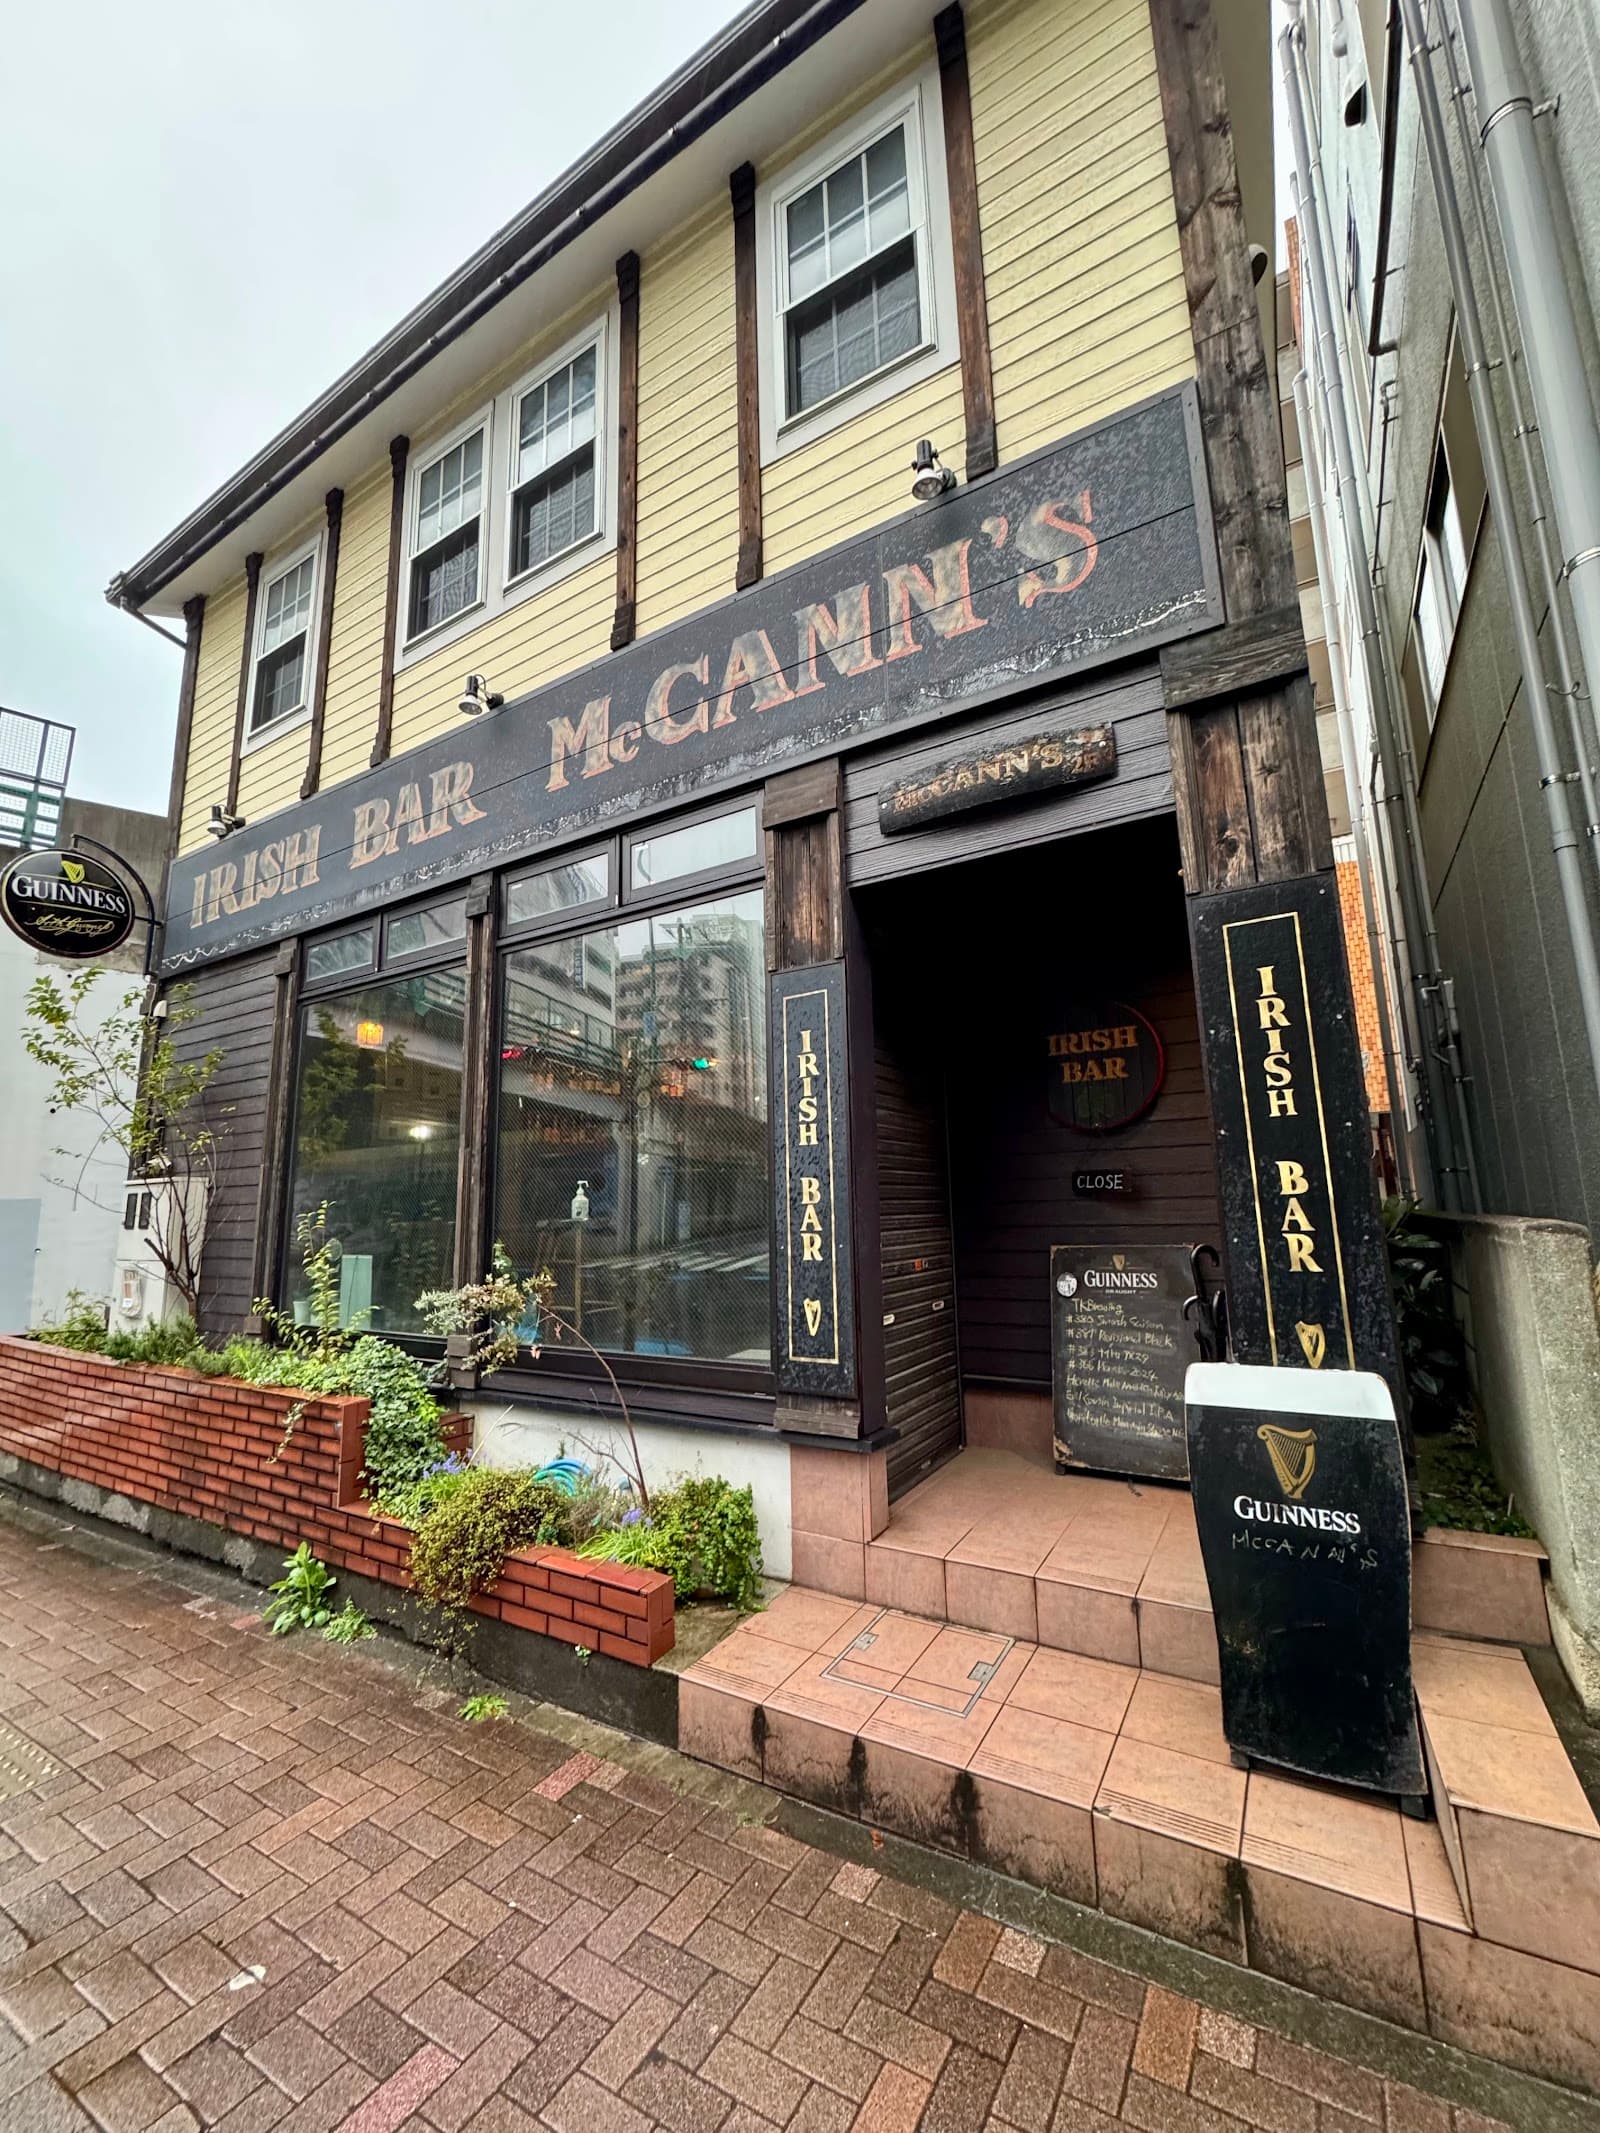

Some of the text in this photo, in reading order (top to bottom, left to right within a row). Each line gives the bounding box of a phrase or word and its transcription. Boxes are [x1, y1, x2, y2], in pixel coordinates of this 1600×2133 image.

[190, 823, 322, 930] IRISH
[349, 760, 488, 870] BAR
[11, 874, 126, 914] GUINNESS
[1047, 1024, 1139, 1057] IRISH
[1061, 1056, 1129, 1084] BAR
[1256, 964, 1325, 1273] IRISH BAR
[796, 1028, 824, 1263] IRISH BAR
[1076, 1173, 1124, 1190] CLOSE
[1083, 1269, 1159, 1289] GUINNESS
[1233, 1494, 1361, 1535] GUINNESS
